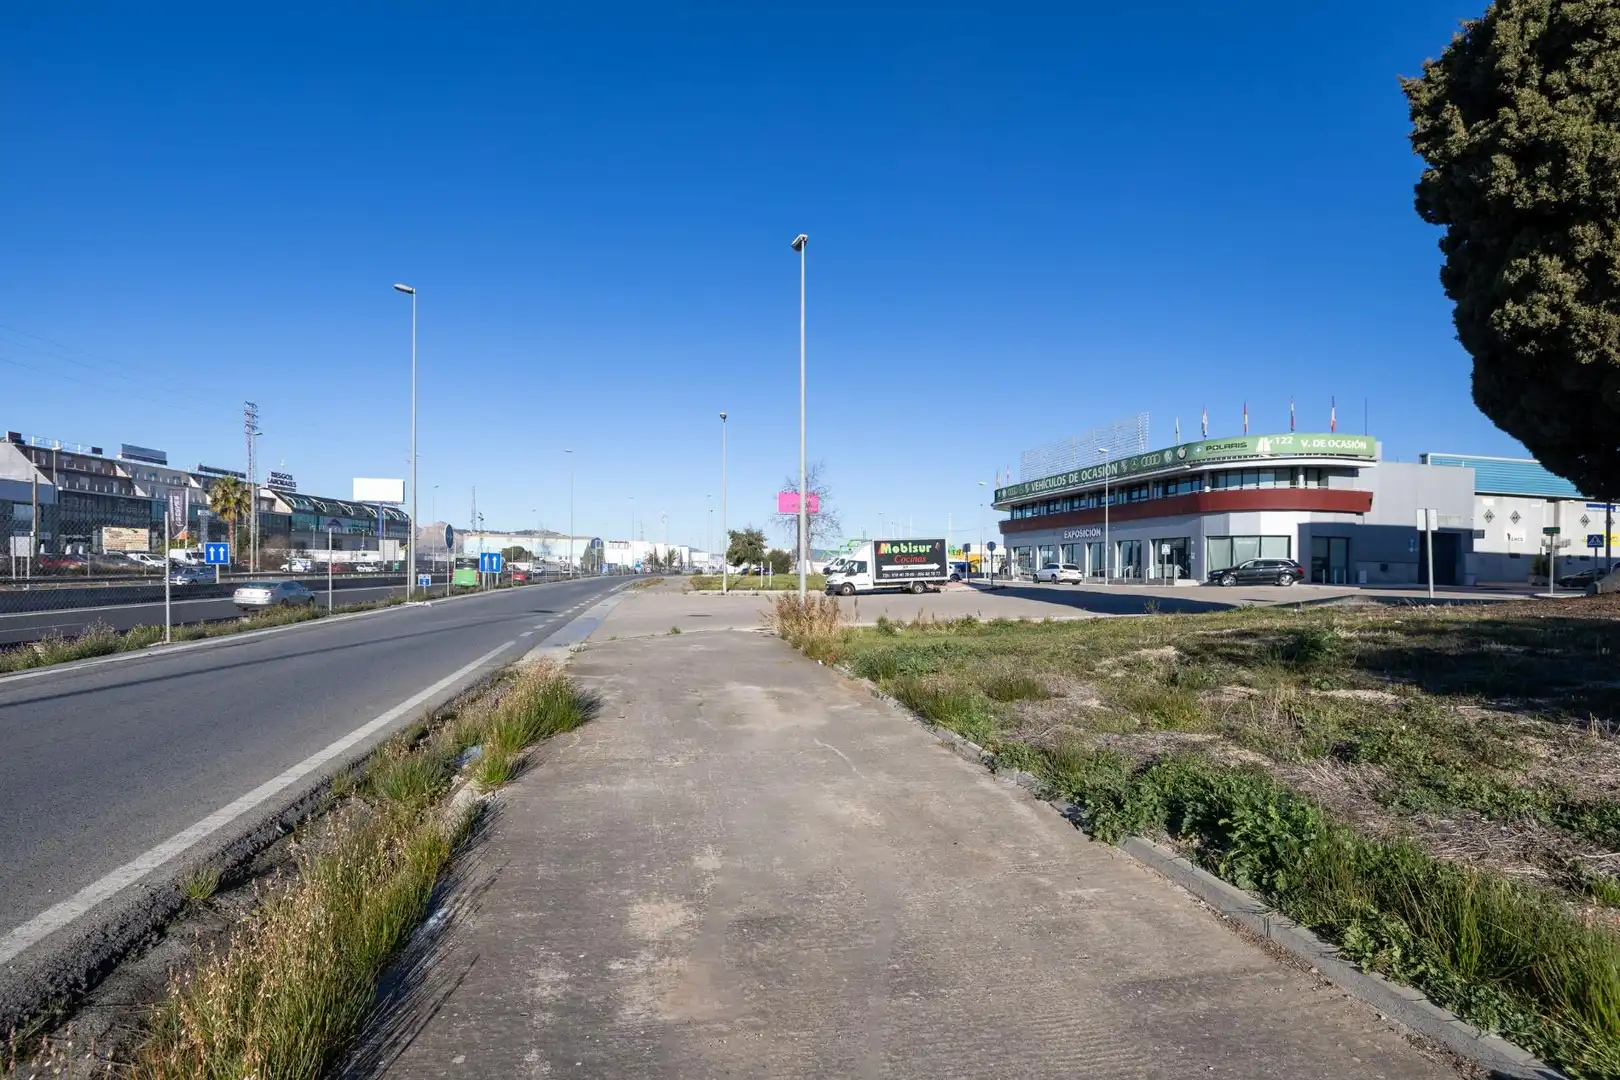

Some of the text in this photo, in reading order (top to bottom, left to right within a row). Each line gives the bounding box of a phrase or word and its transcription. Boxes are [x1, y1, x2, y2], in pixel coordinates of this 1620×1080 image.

[1275, 436, 1294, 445] 122
[1301, 439, 1311, 448] V.
[1312, 439, 1326, 448] DE
[1205, 442, 1248, 451] POLARIS
[1068, 472, 1079, 484] DE
[878, 542, 932, 555] Mobisur
[894, 555, 926, 564] Cocinas
